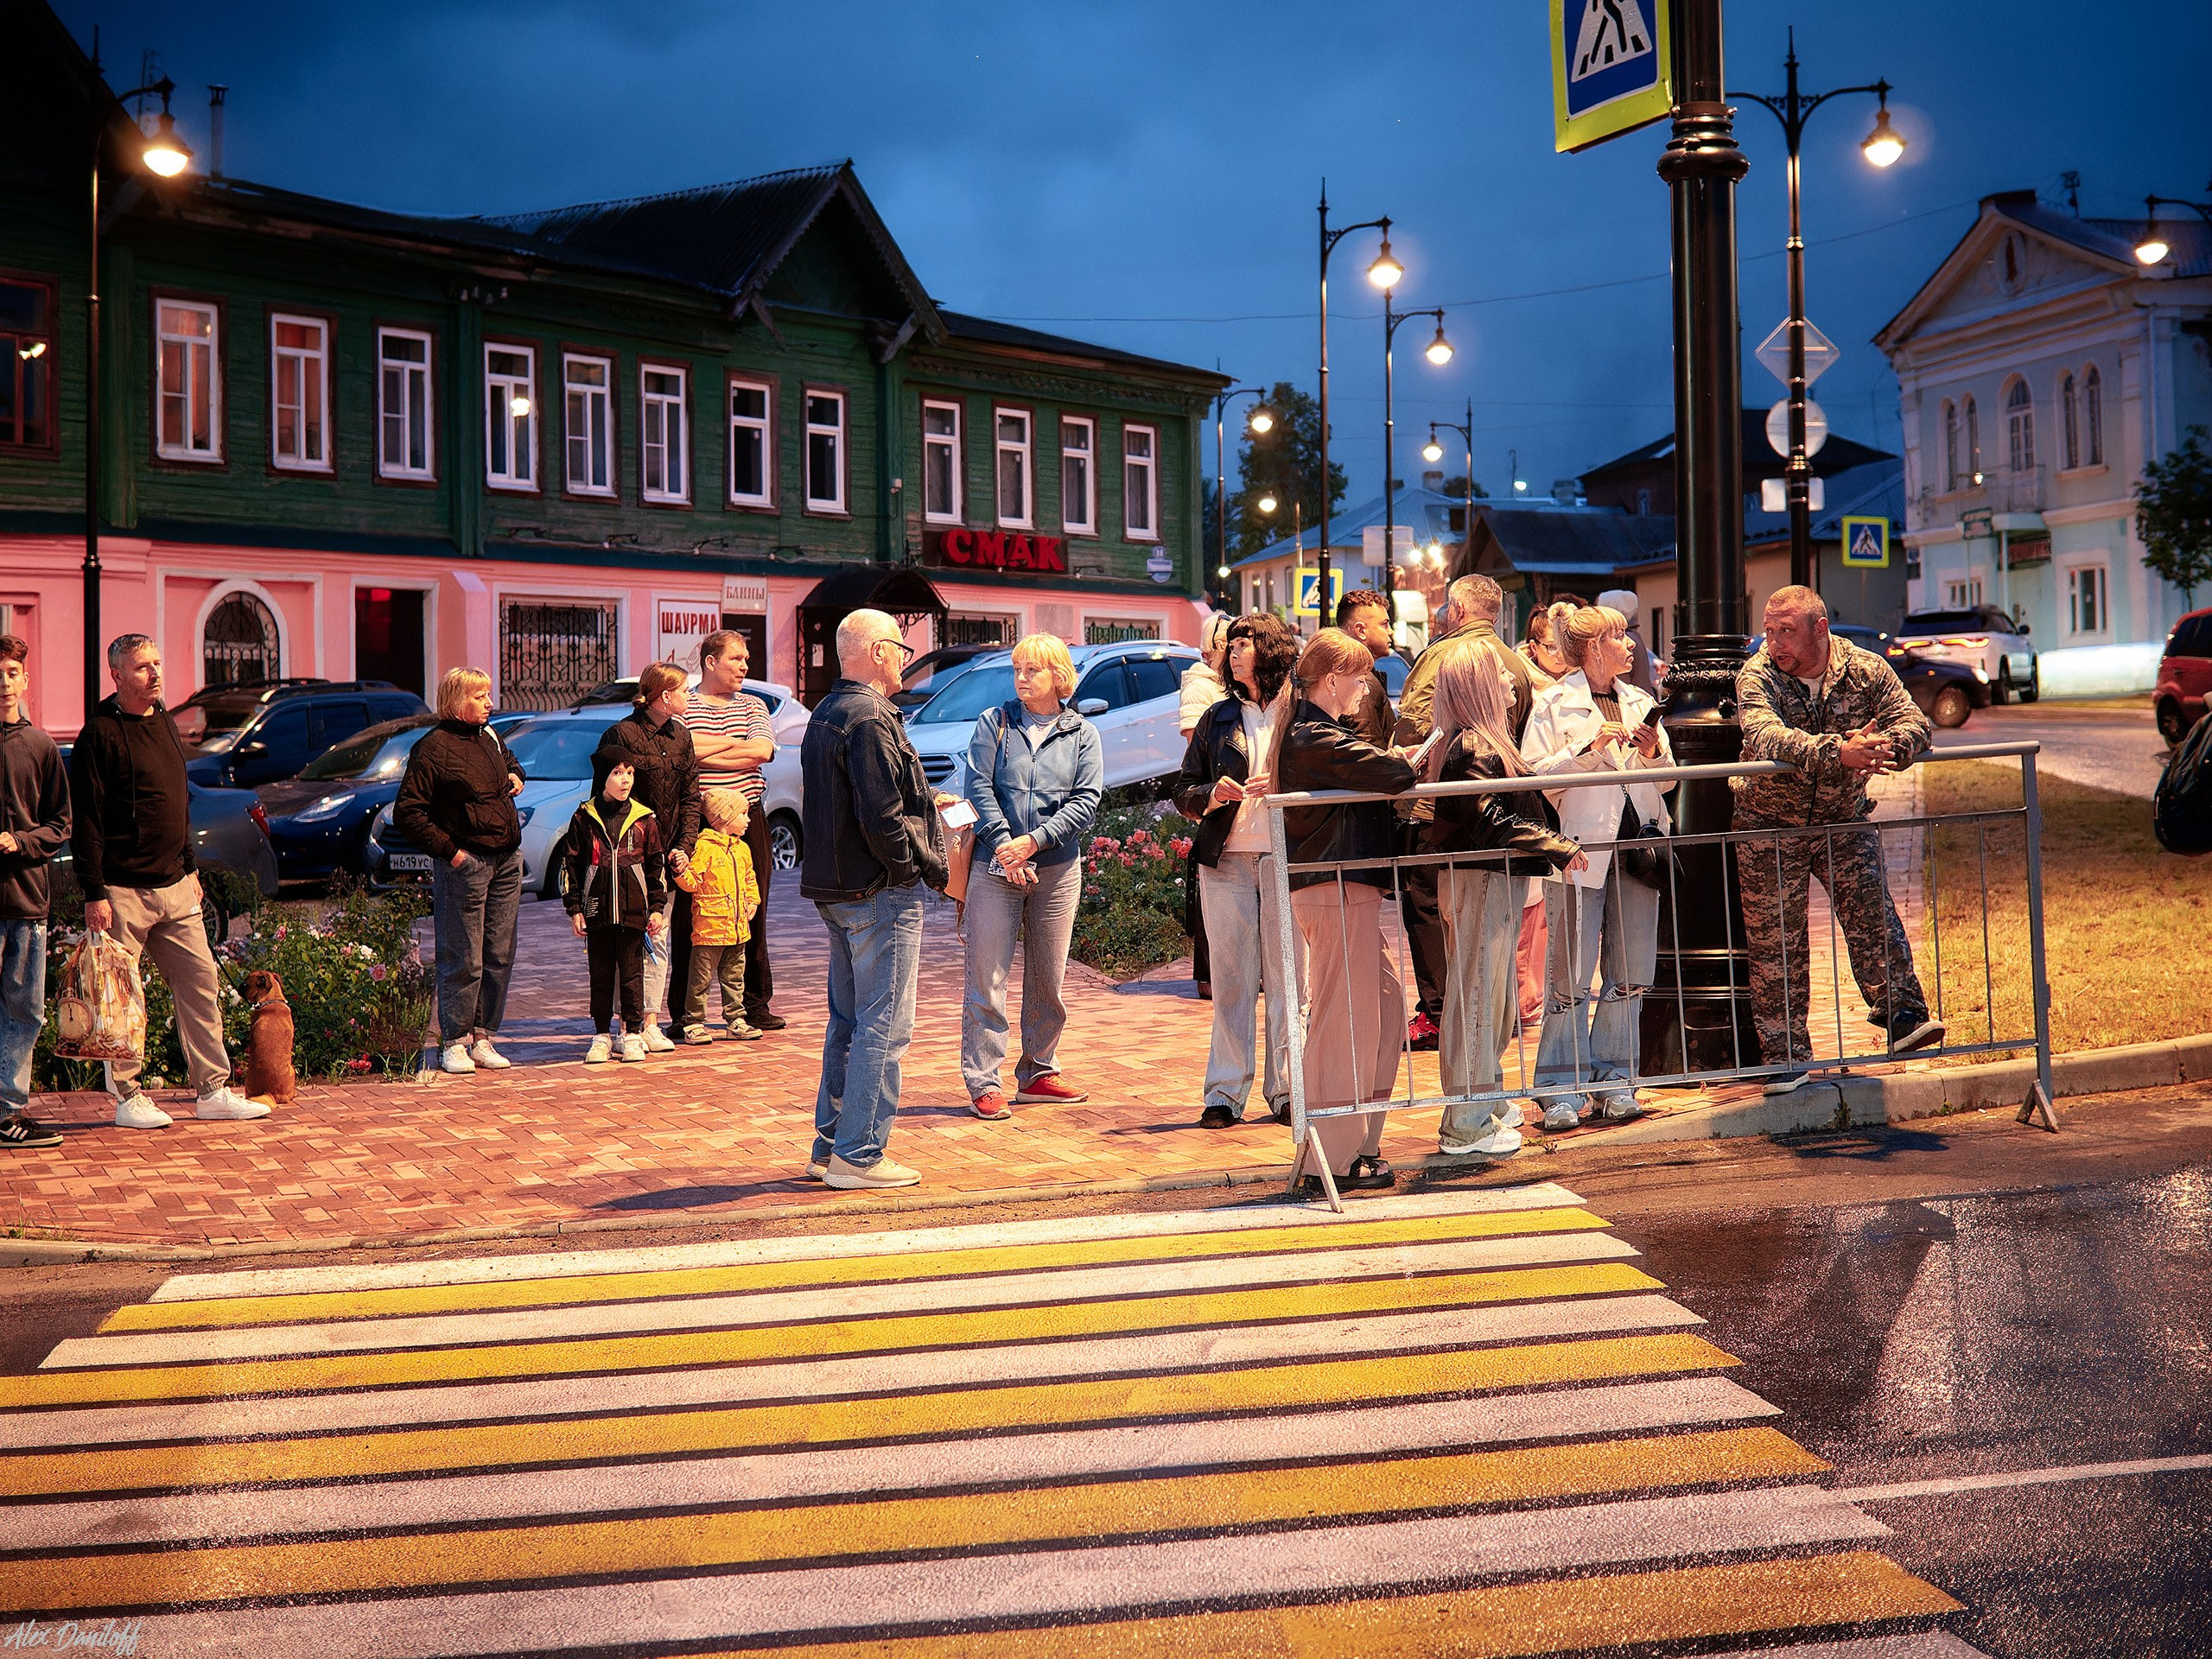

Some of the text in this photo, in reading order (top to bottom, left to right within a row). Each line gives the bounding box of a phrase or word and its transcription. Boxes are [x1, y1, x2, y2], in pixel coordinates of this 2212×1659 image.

[941, 528, 1065, 571] СМАК
[726, 587, 765, 600] БЛИНЫ
[661, 612, 717, 634] ШАУРМА
